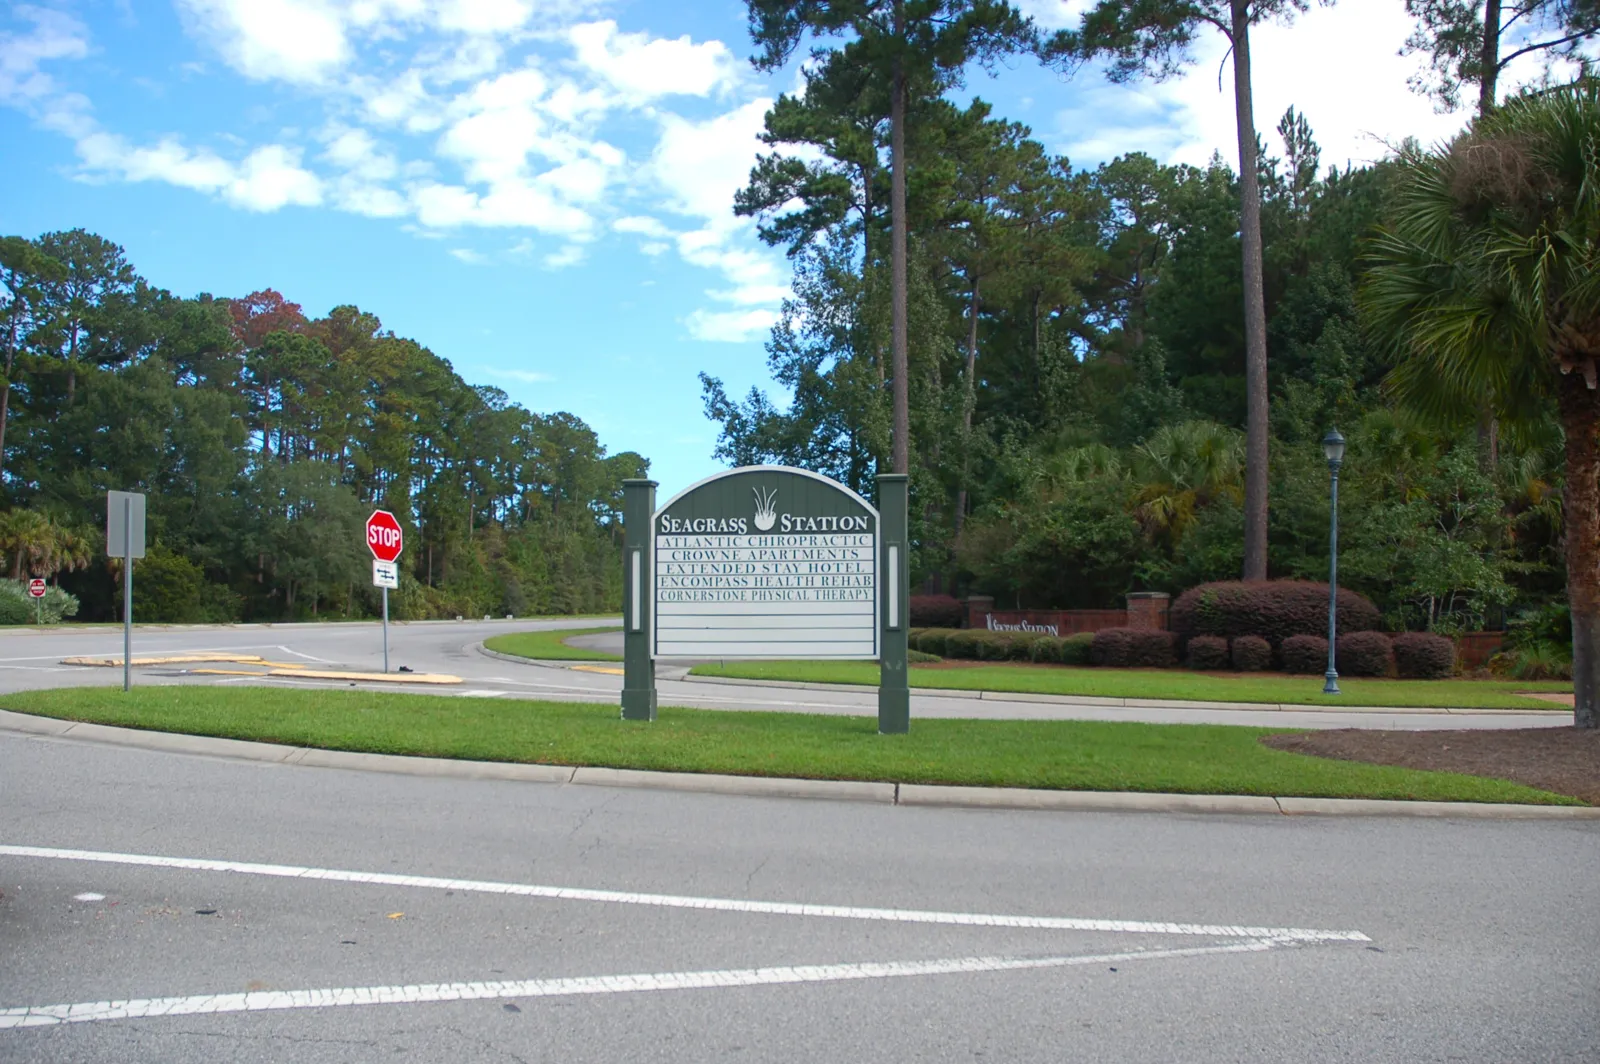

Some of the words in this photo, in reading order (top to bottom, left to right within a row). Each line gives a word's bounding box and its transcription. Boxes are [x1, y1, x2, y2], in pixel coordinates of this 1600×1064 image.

[661, 514, 748, 535] SEAGRASS
[780, 513, 869, 532] STATION
[369, 524, 400, 548] STOP
[662, 536, 742, 547] ATLANTIC
[748, 535, 868, 547] CHIROPRACTIC
[671, 550, 741, 561] CROWNE
[748, 549, 859, 560] APARTMENTS
[666, 563, 756, 574] EXTENDED
[762, 563, 801, 574] STAY
[809, 562, 865, 573] HOTEL
[661, 576, 749, 587] ENCOMPASS
[754, 576, 814, 587] HEALTH
[821, 575, 871, 586] REHAB
[660, 590, 747, 601] CORNERSTONE
[751, 590, 810, 601] PHYSICAL
[814, 589, 871, 600] THERAPY
